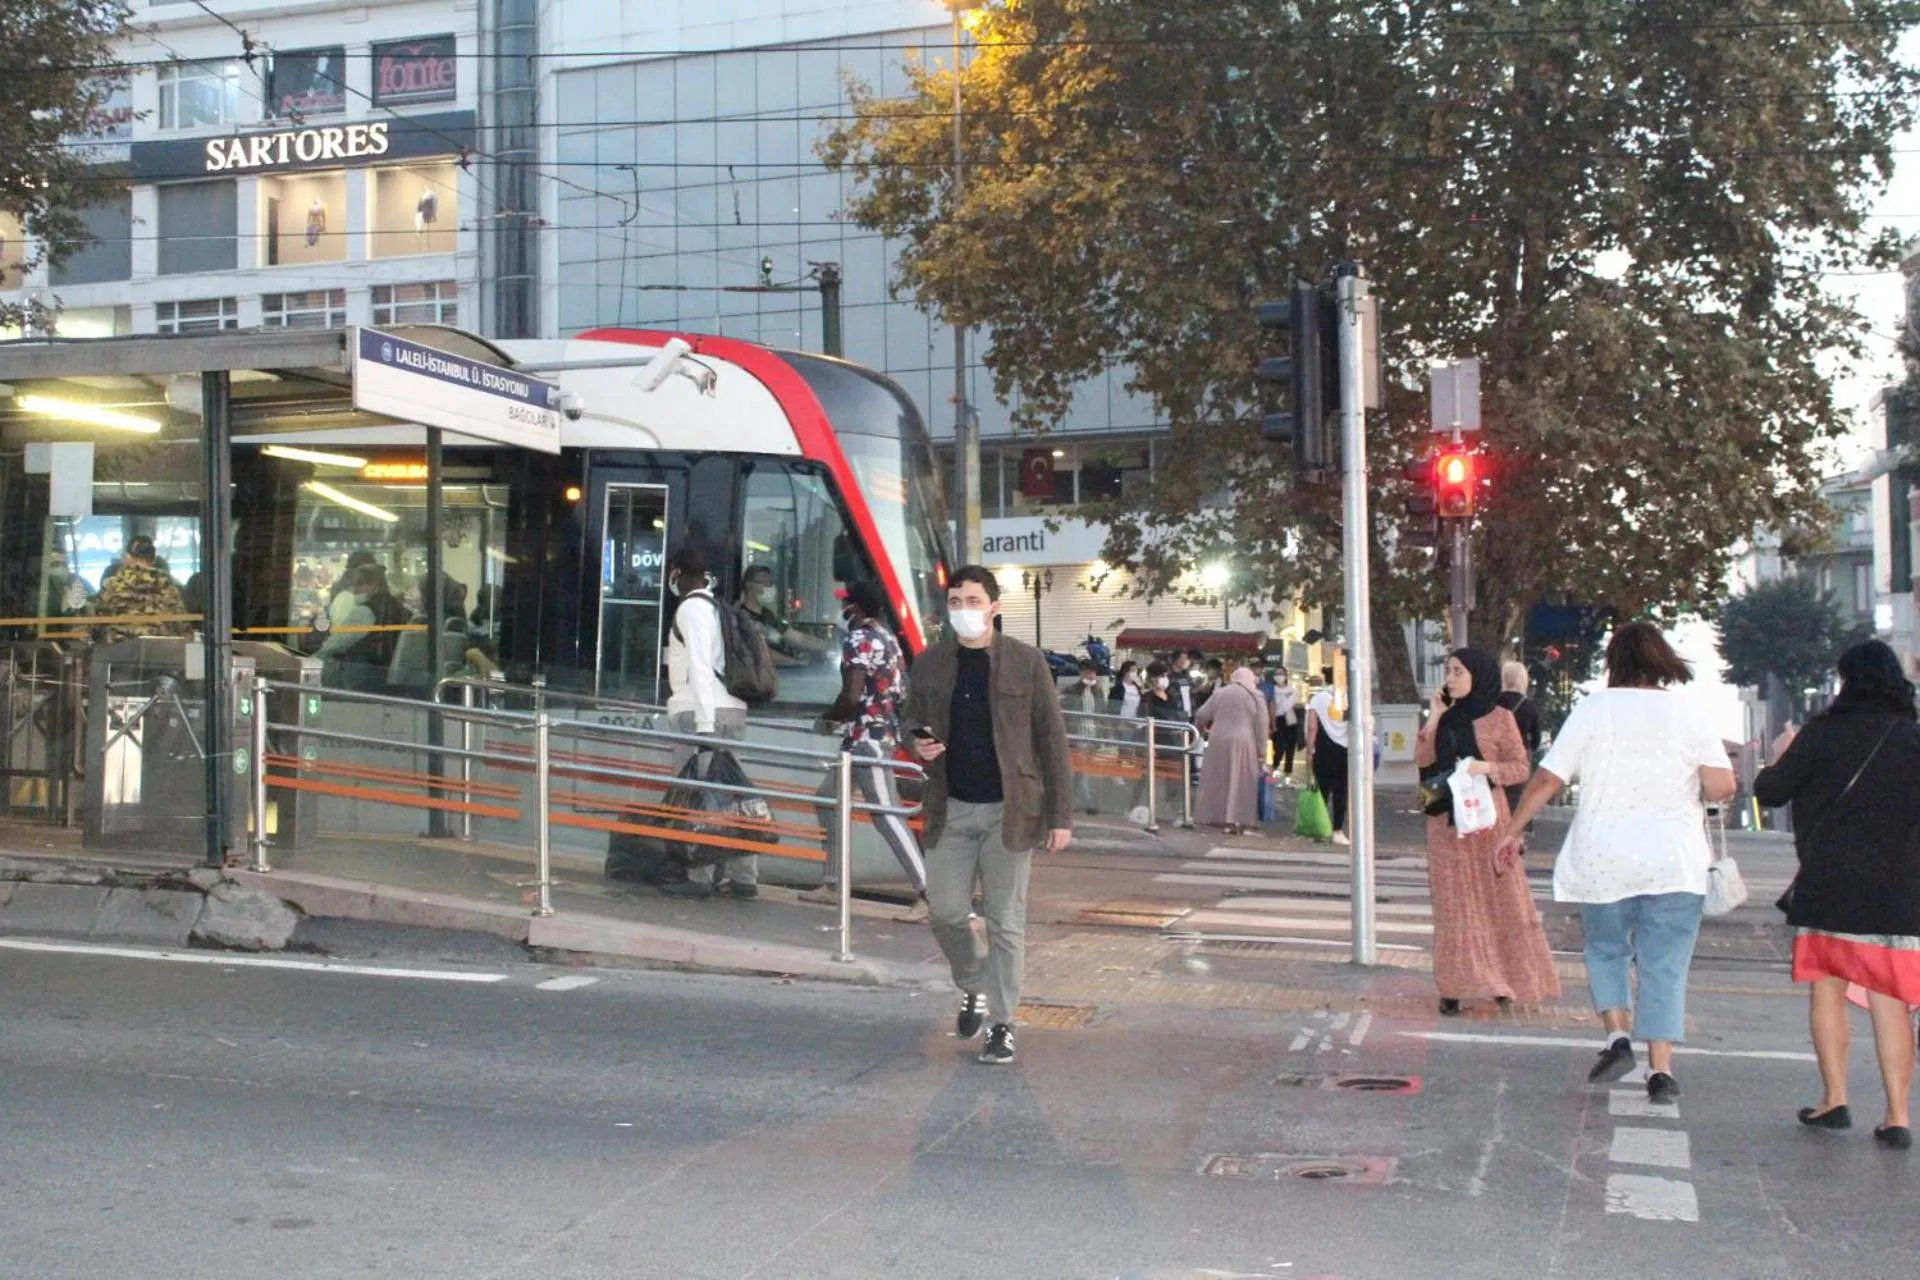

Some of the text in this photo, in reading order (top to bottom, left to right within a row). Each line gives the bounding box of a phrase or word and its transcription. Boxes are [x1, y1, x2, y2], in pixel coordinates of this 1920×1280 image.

[206, 122, 388, 171] SARTORES
[395, 347, 470, 382] LALELİ-İSTANBUL
[982, 530, 1044, 553] aranti
